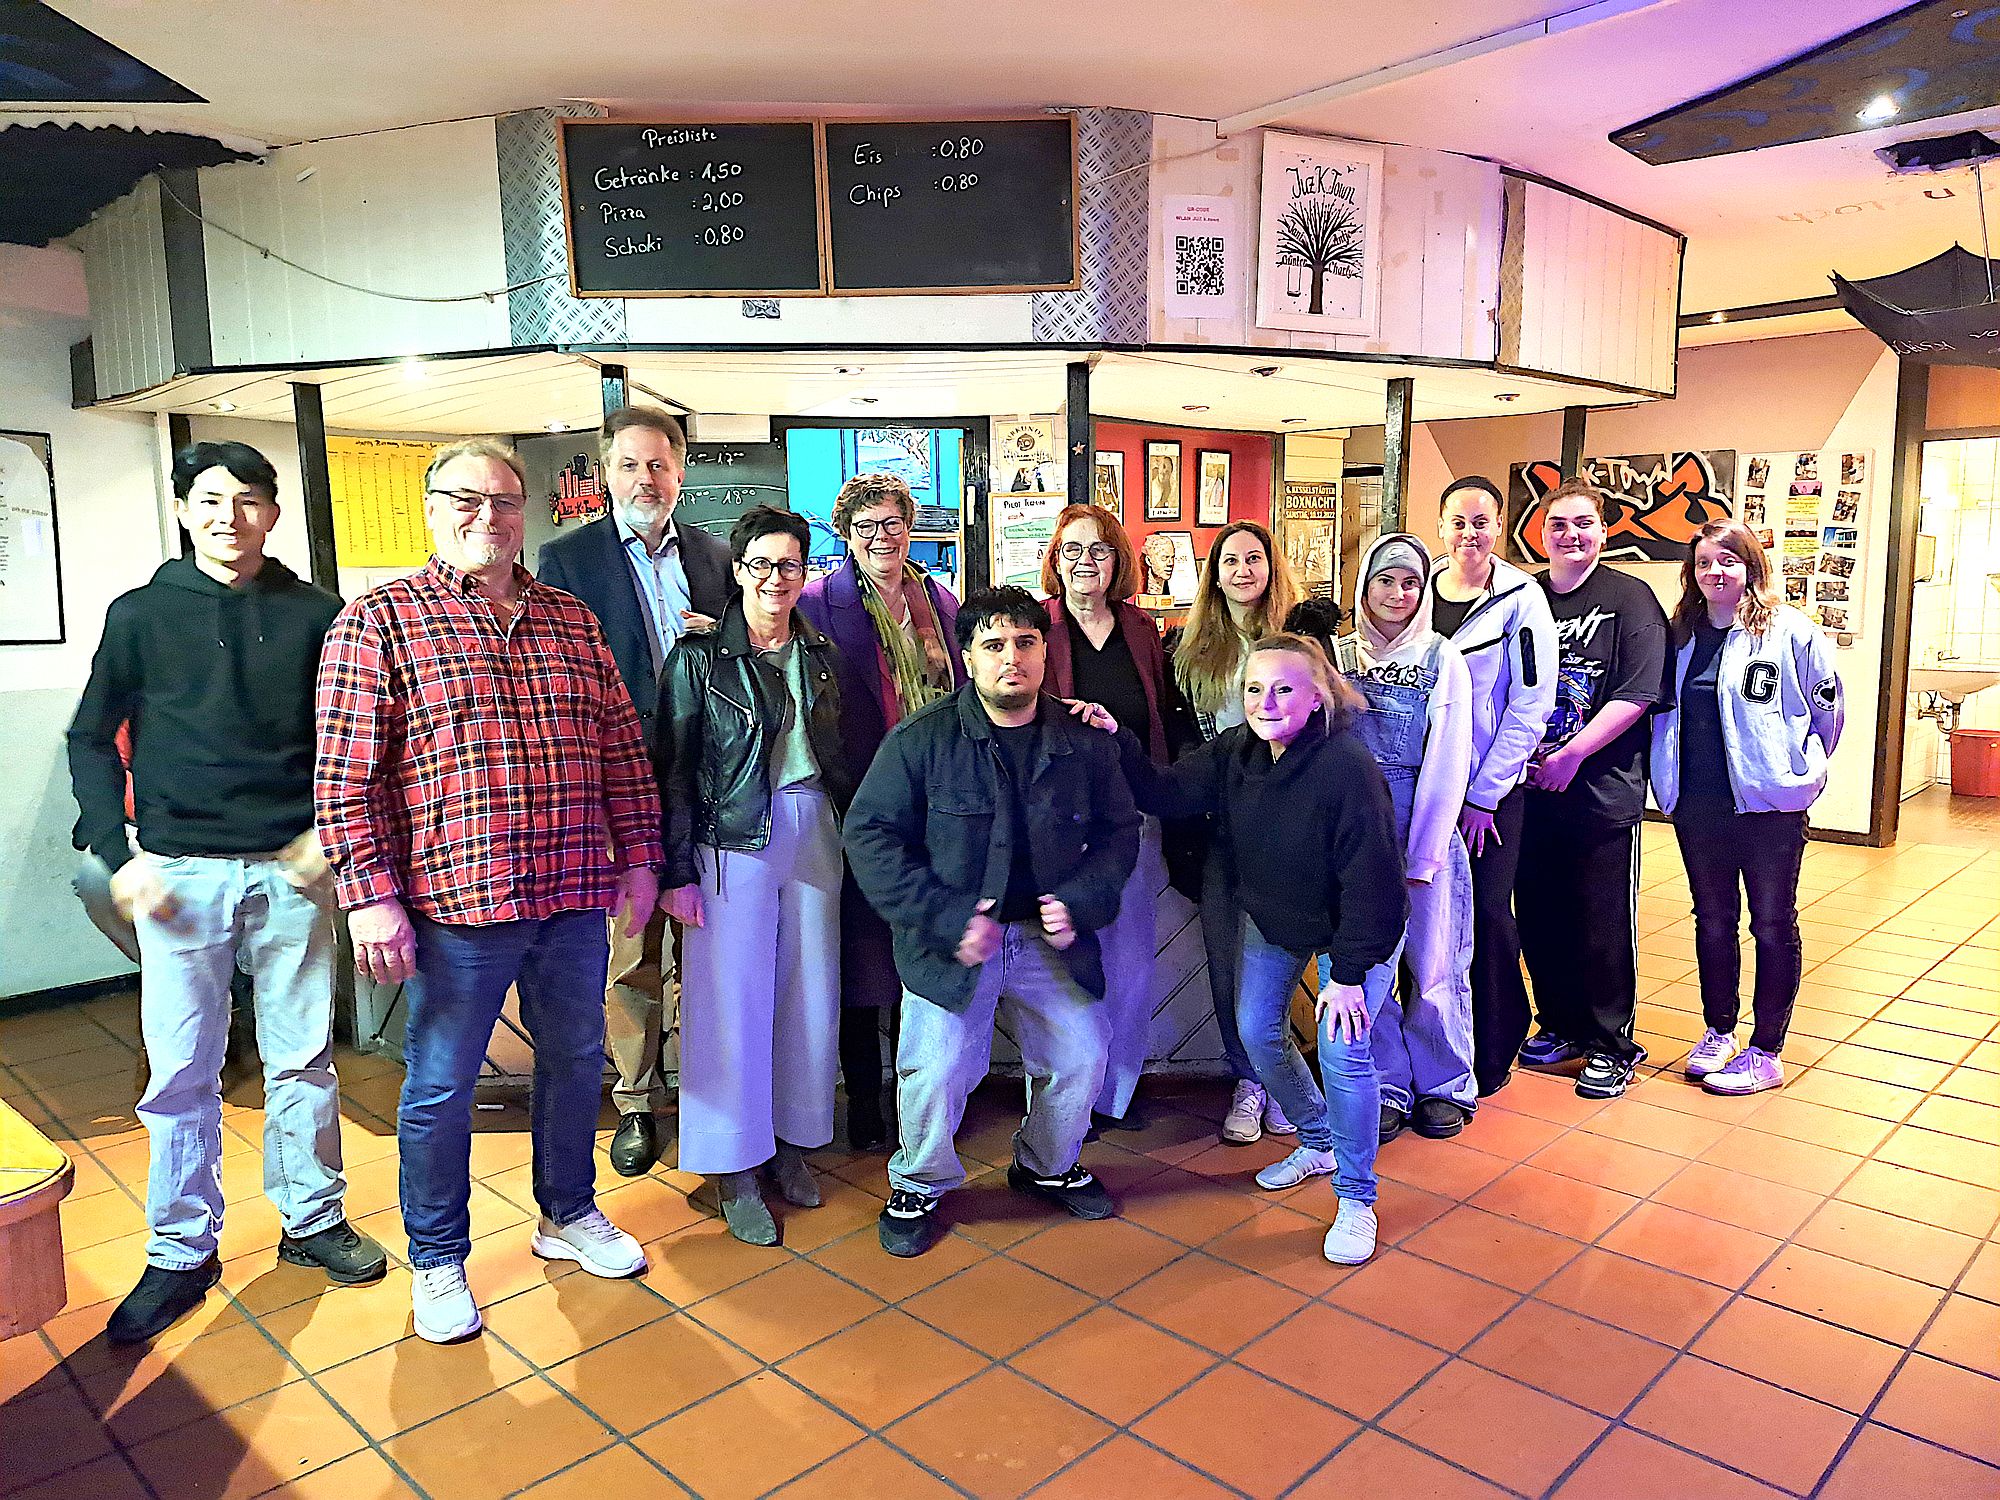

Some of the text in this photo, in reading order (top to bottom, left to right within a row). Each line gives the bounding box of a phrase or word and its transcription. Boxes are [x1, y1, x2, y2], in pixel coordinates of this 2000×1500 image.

[642, 128, 717, 148] Preisliste
[855, 143, 882, 164] Eis
[594, 165, 679, 191] Getränke
[850, 185, 901, 208] Chips
[599, 203, 646, 224] Pizza
[605, 233, 662, 258] Schoki
[1285, 495, 1336, 509] BOXNACHT
[1741, 660, 1779, 704] G
